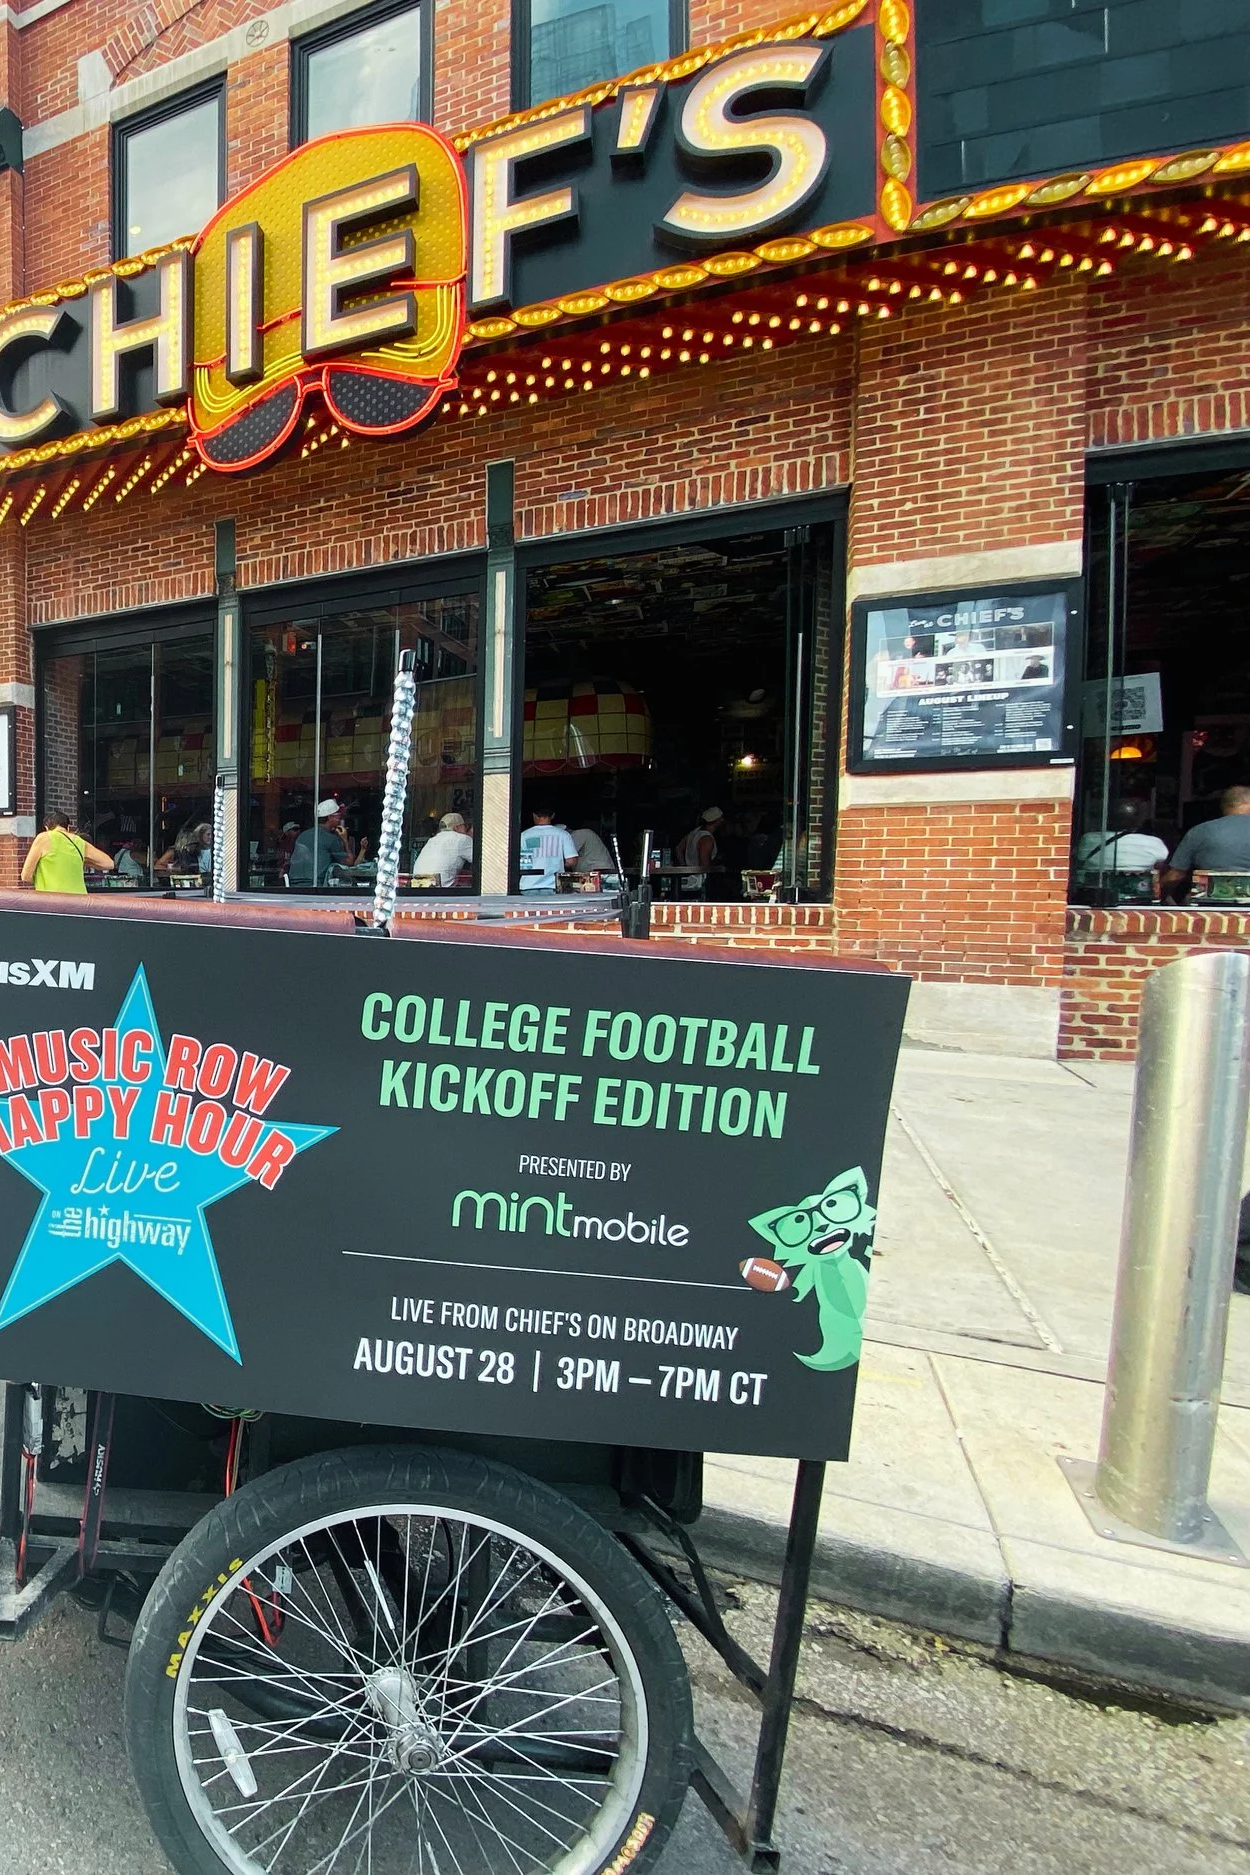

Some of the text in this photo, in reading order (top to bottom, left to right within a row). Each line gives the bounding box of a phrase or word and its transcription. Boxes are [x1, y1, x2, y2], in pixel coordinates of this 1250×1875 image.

[936, 607, 1025, 628] CHIEF'S
[918, 692, 1010, 707] AUGUST LINEUP
[361, 992, 821, 1076] COLLEGE FOOTBALL
[163, 1033, 291, 1116] ROW
[378, 1060, 789, 1139] KICKOFF EDITION
[70, 1146, 181, 1195] Live
[150, 1089, 299, 1191] HOUR
[519, 1154, 632, 1182] PRESENTED BY
[48, 1206, 192, 1256] ON the highway
[390, 1296, 739, 1351] LIVE FROM CHIEF'S ON BROADWAY
[353, 1338, 473, 1382] AUGUST
[477, 1352, 514, 1385] 28
[556, 1356, 620, 1394] 3PM
[657, 1366, 721, 1403] 7PM
[729, 1372, 768, 1406] CT
[165, 1556, 243, 1680] MAXXIS
